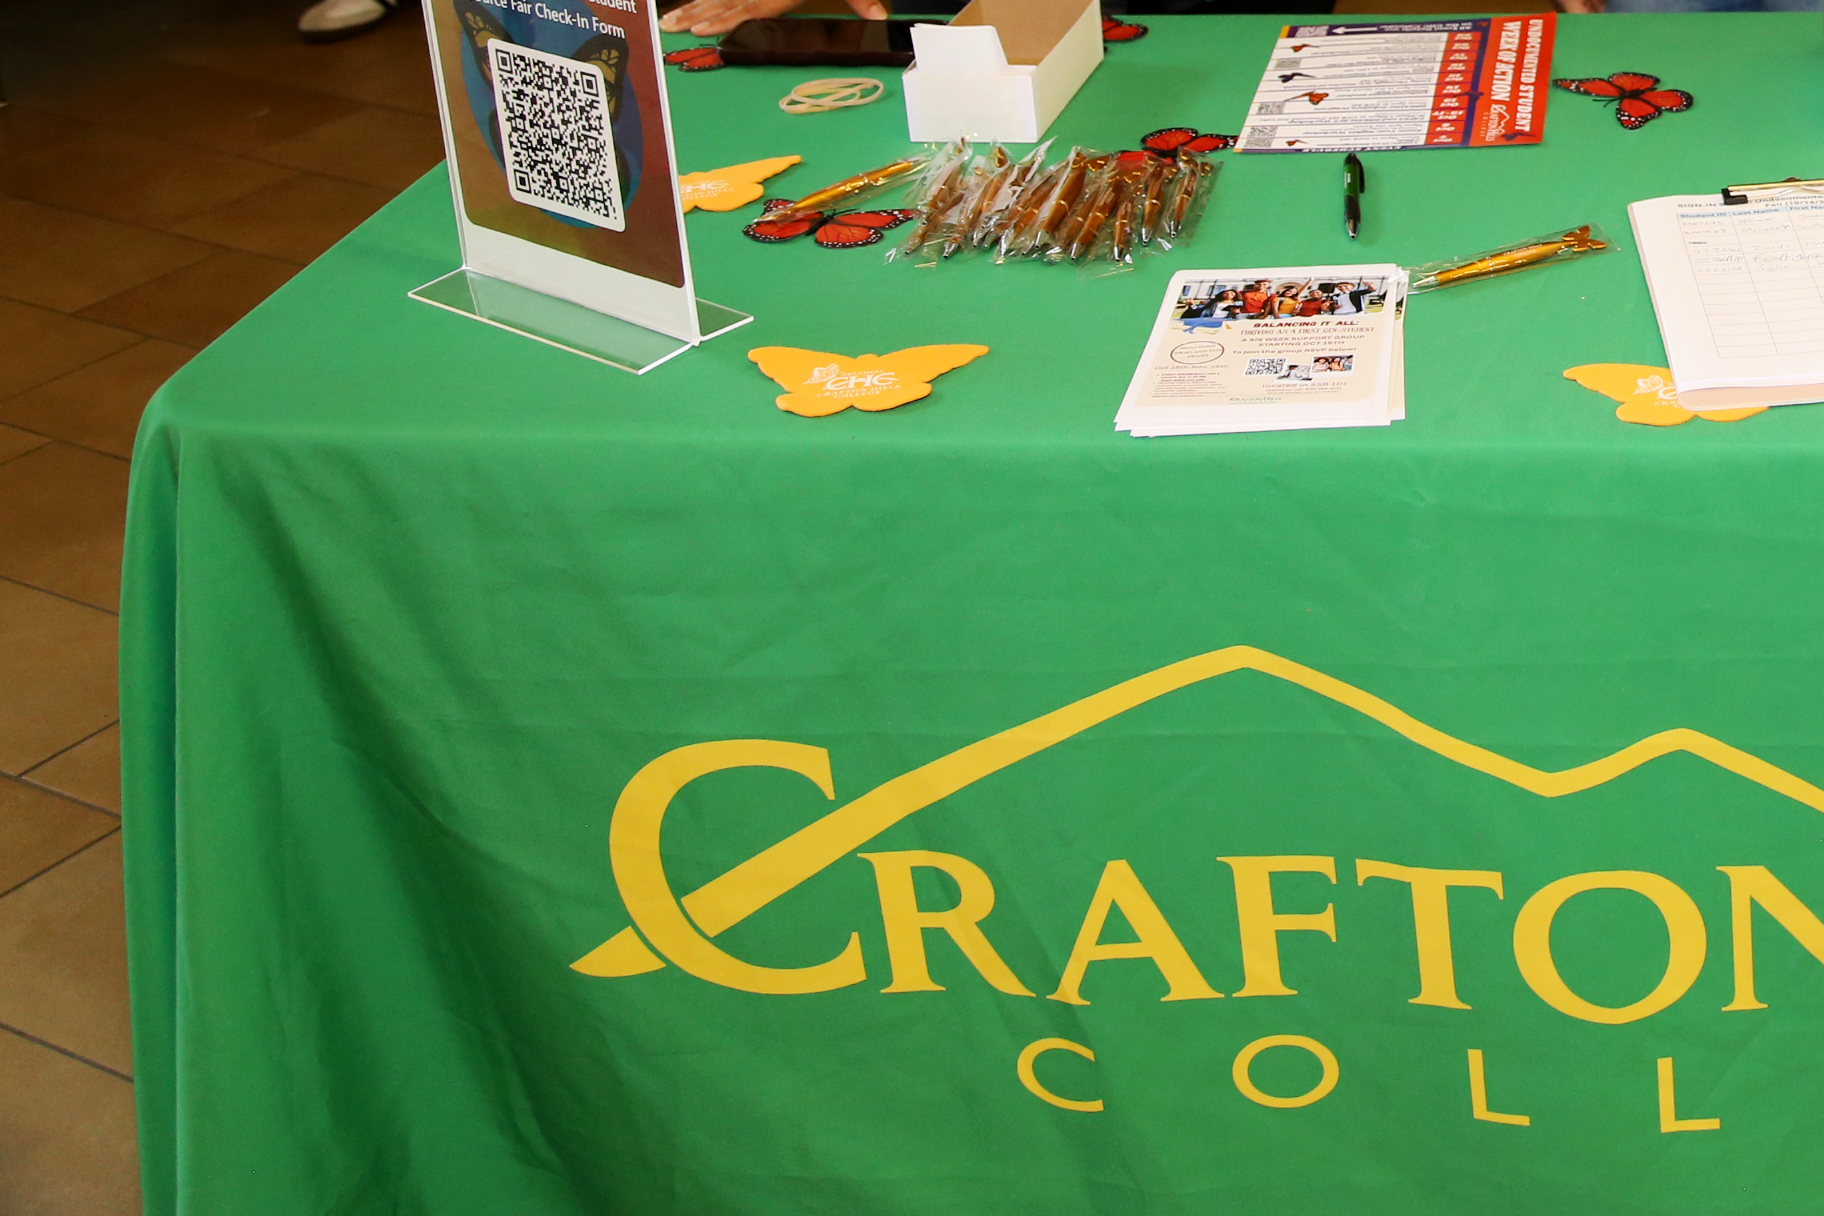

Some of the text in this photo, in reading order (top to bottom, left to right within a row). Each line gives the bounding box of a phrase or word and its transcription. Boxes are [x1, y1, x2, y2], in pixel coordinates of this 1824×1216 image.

[535, 2, 590, 30] Check-In
[592, 16, 626, 39] Form
[1490, 20, 1522, 101] WEEK OF ACTION
[1514, 18, 1544, 132] UNDOCUMENTED STUDENT
[1240, 328, 1275, 336] THRIVING
